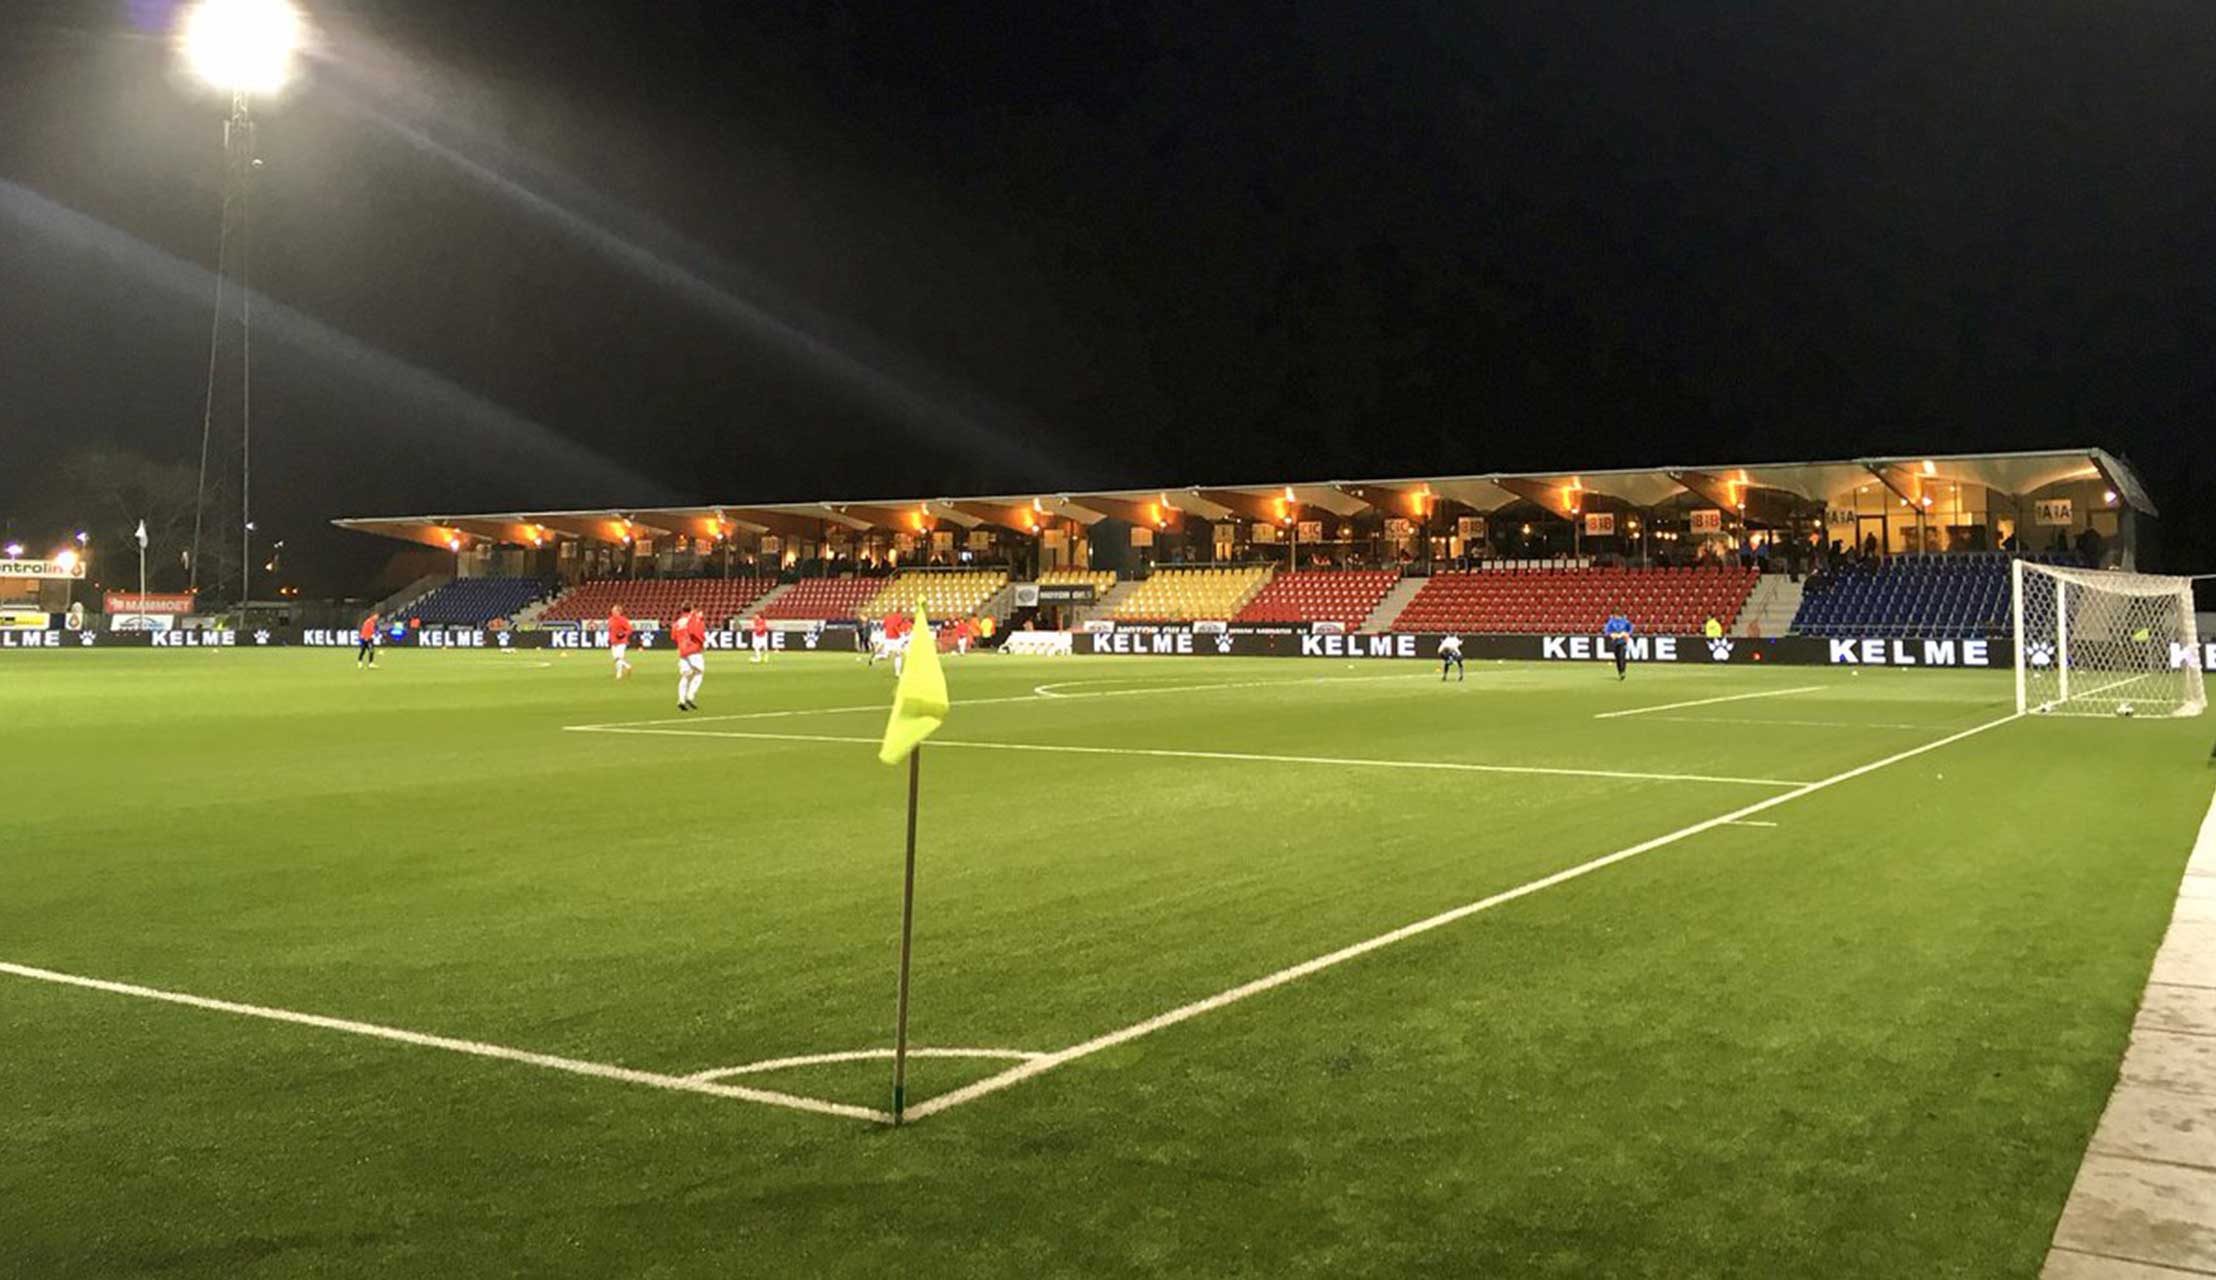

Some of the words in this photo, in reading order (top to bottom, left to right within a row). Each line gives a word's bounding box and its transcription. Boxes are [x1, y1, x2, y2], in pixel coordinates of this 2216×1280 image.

[152, 631, 235, 645] KELME
[303, 630, 361, 645] KELME
[419, 630, 484, 646] KELME
[552, 631, 610, 647] KELM
[704, 631, 785, 648] KELE
[1093, 633, 1193, 653] KELME
[1302, 635, 1416, 656] KELME
[1543, 637, 1677, 659] KELME
[1829, 639, 1989, 665] KELME
